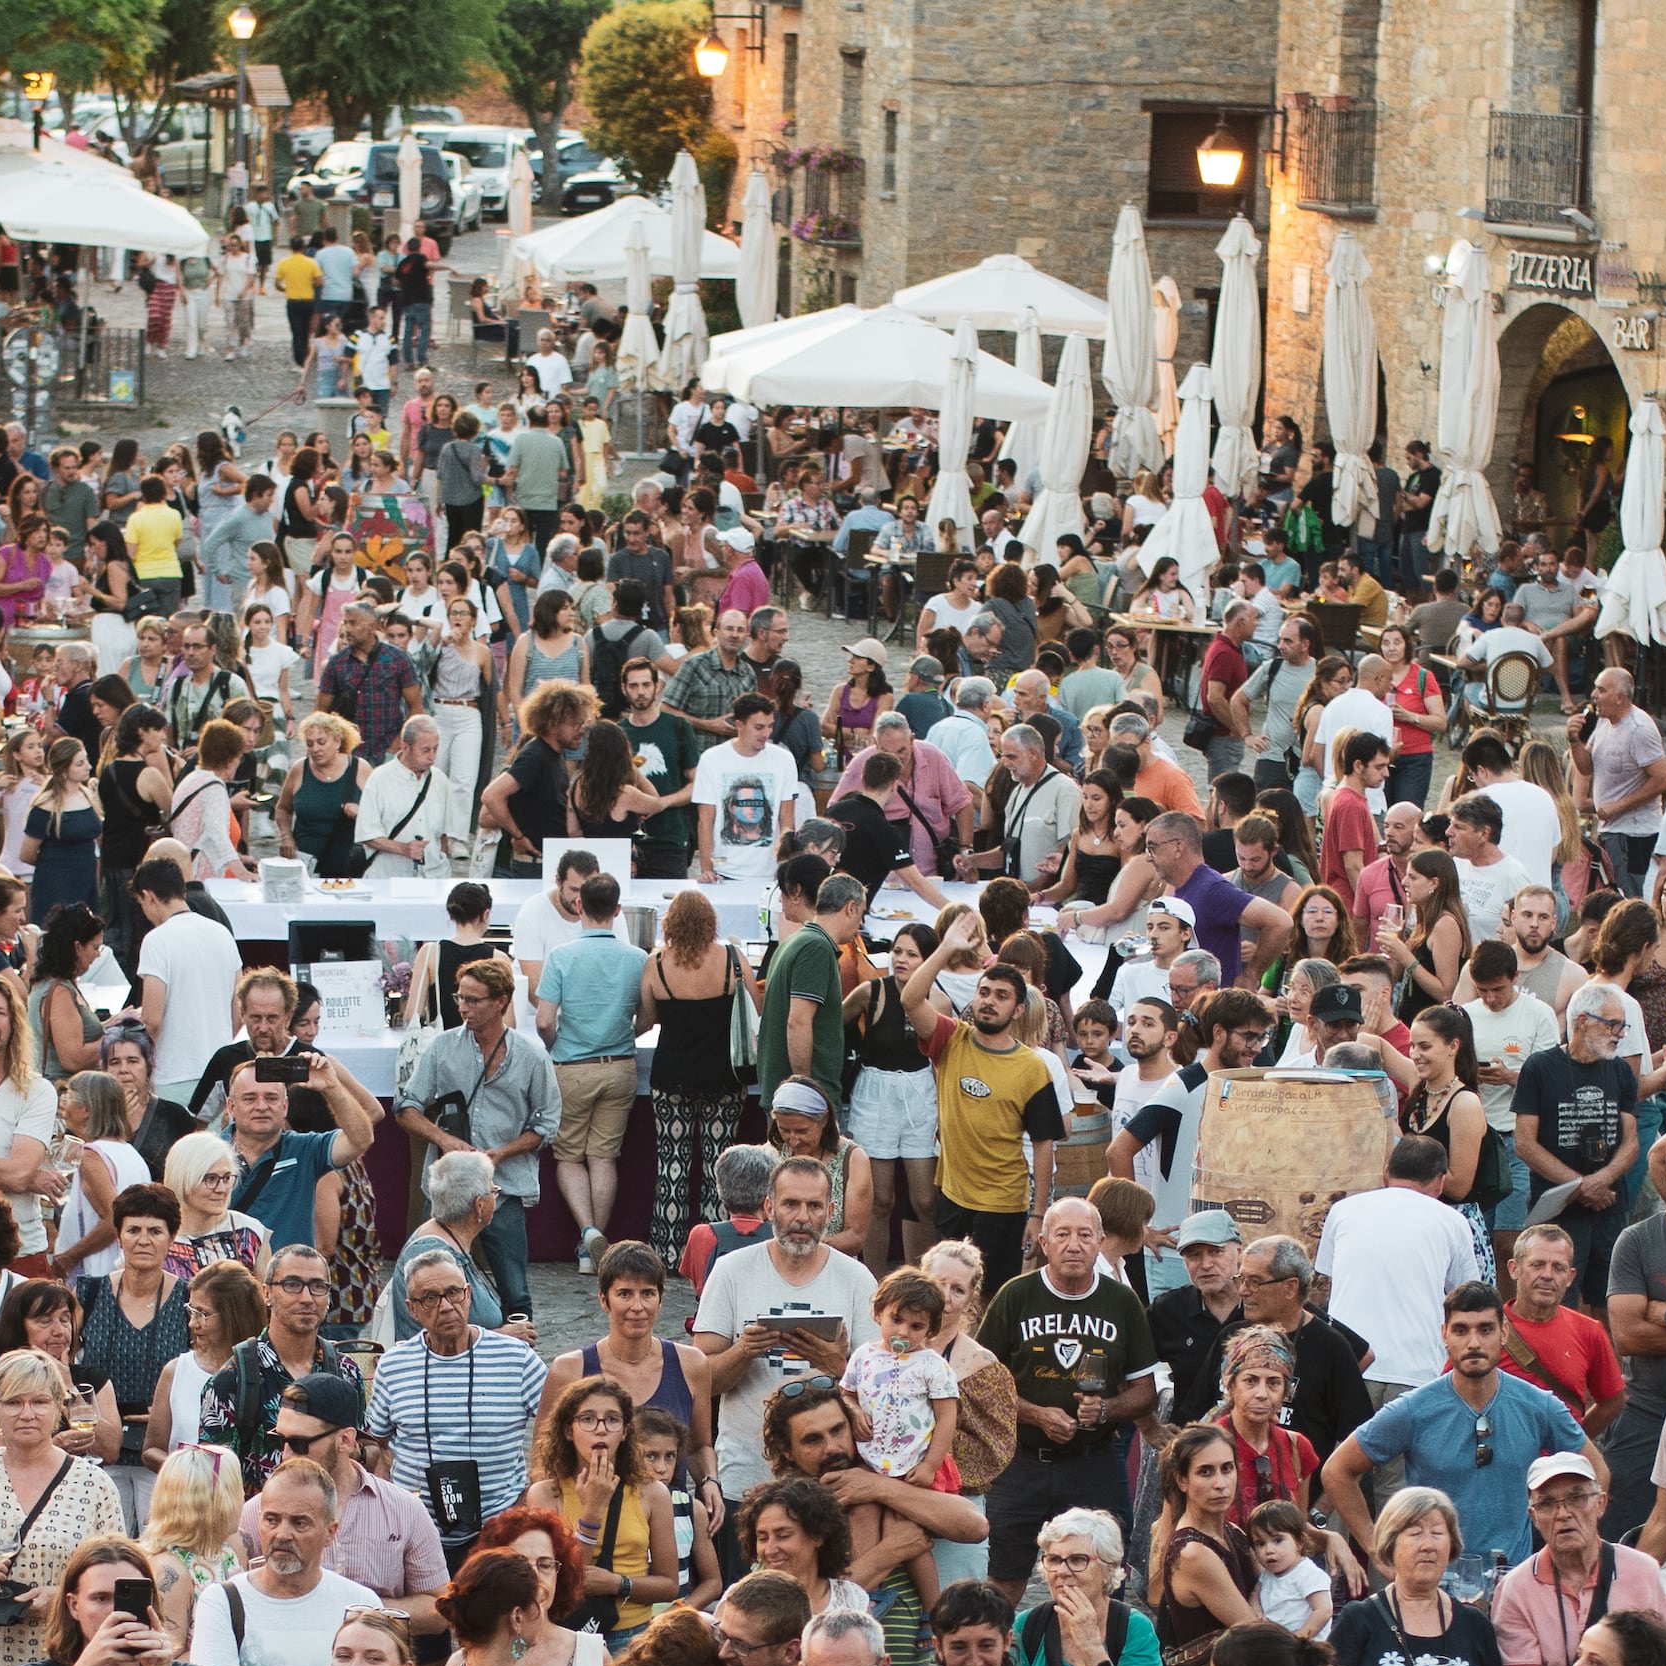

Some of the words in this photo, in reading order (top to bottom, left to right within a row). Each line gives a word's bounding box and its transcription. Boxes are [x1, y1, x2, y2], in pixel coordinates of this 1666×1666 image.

[1507, 251, 1594, 293] PIZZERIA
[1613, 317, 1652, 350] BAR
[327, 1008, 336, 1018] DE
[1020, 1313, 1117, 1343] IRELAND
[440, 1484, 452, 1495] SO
[442, 1493, 463, 1504] MON
